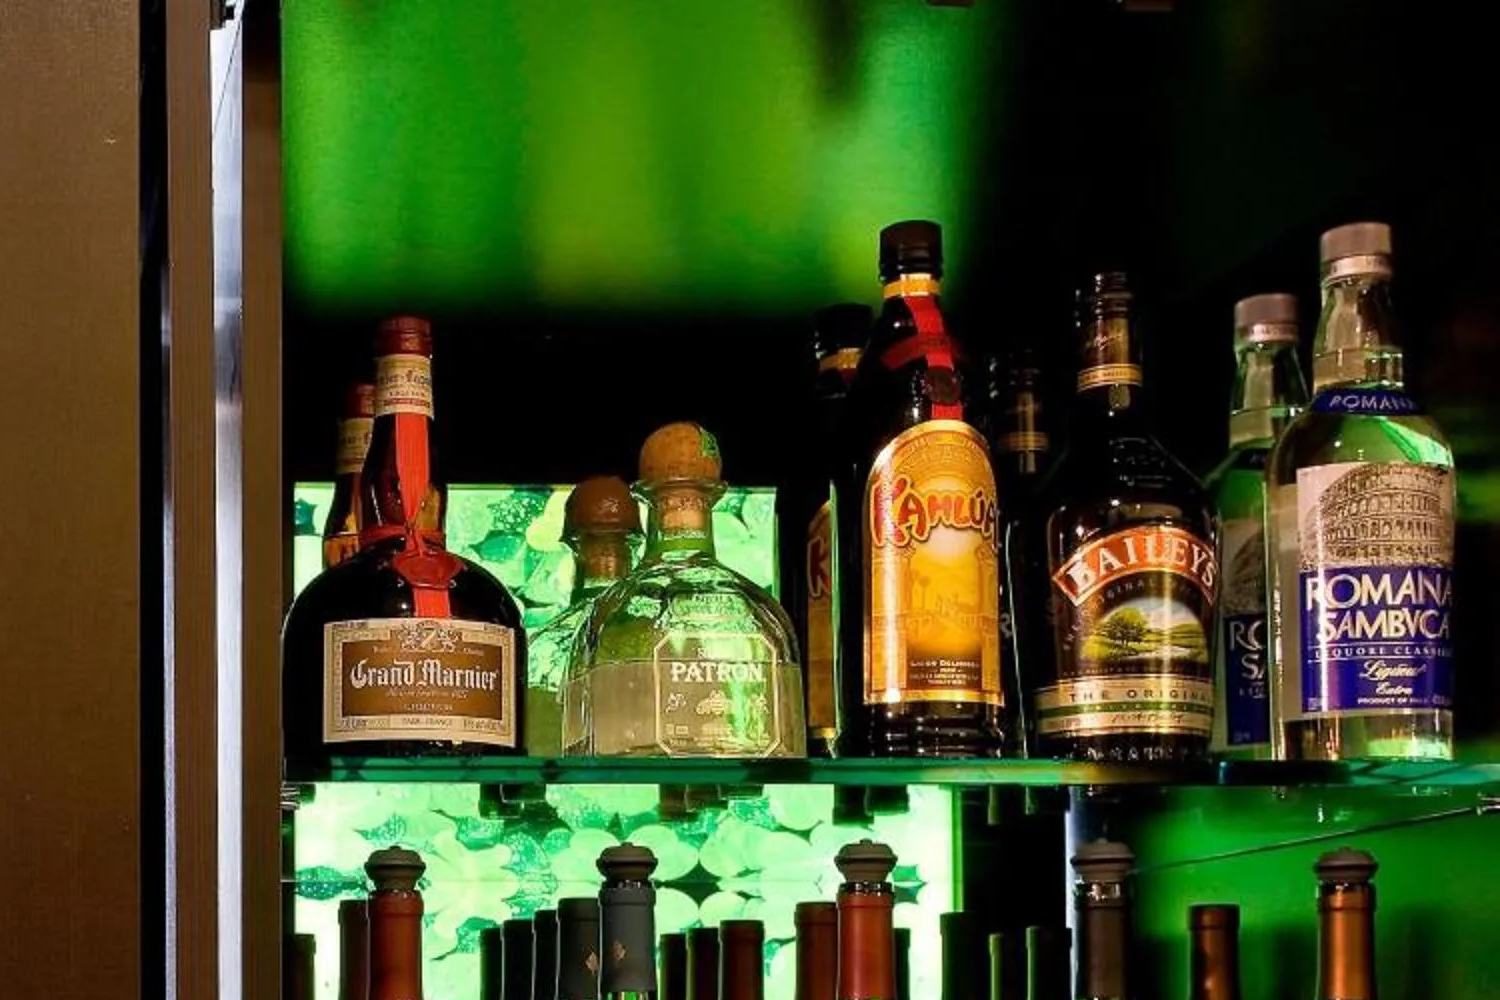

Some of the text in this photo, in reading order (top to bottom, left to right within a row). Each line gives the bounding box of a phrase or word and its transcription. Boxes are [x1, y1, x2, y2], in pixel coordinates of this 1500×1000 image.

[1066, 532, 1219, 590] BAILEYS
[1306, 570, 1451, 612] ROMANA
[1315, 607, 1450, 643] SAMBVCA
[1315, 646, 1384, 659] LQUORE
[350, 659, 498, 691] Grand Marnier
